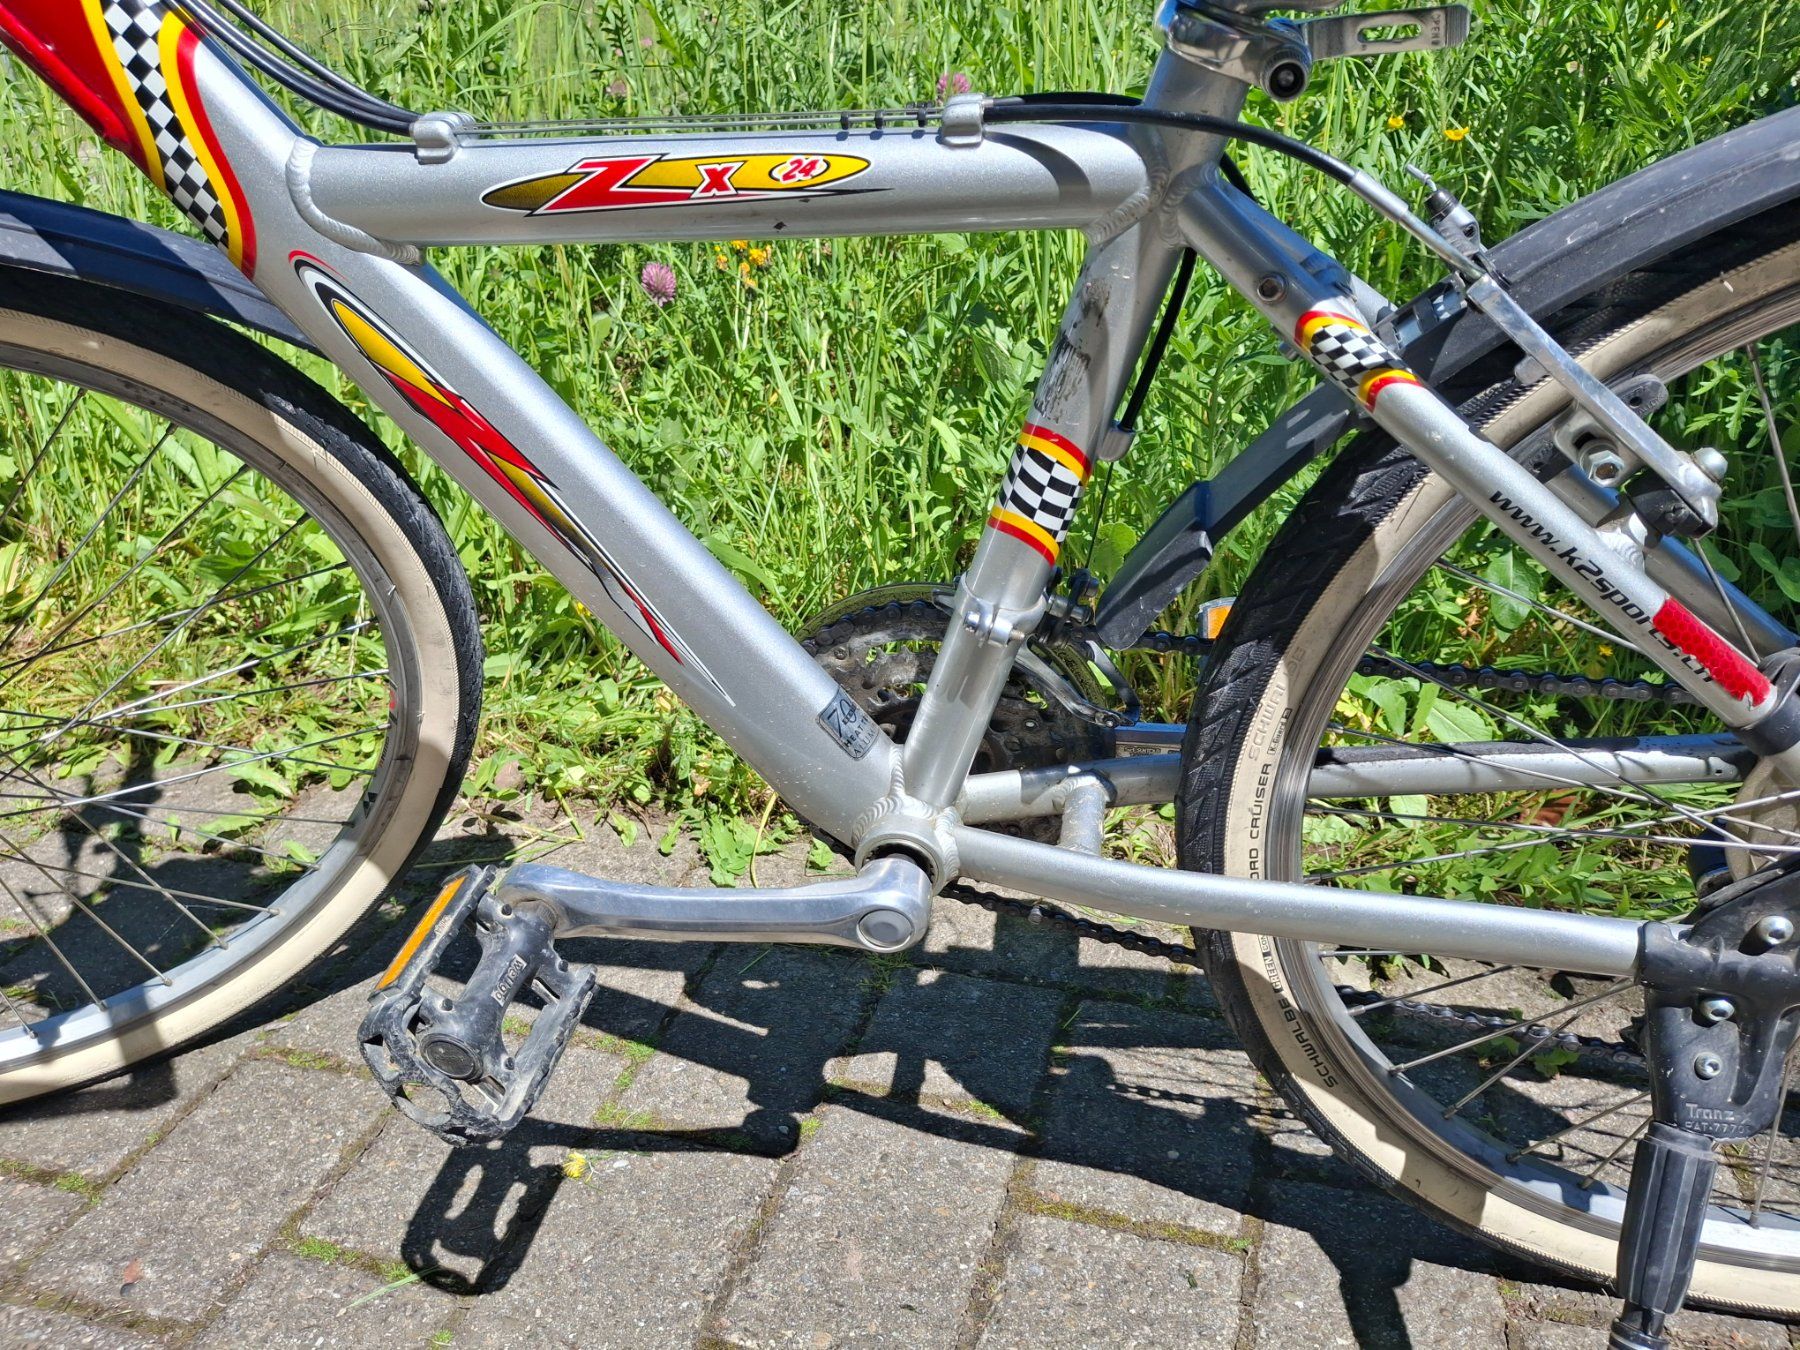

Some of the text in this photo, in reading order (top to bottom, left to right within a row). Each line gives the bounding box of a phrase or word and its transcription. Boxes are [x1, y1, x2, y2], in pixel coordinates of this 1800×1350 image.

[780, 157, 819, 183] 24
[1249, 763, 1272, 840] CRUISER
[1264, 956, 1338, 1088] SCHWALBE GREEN
